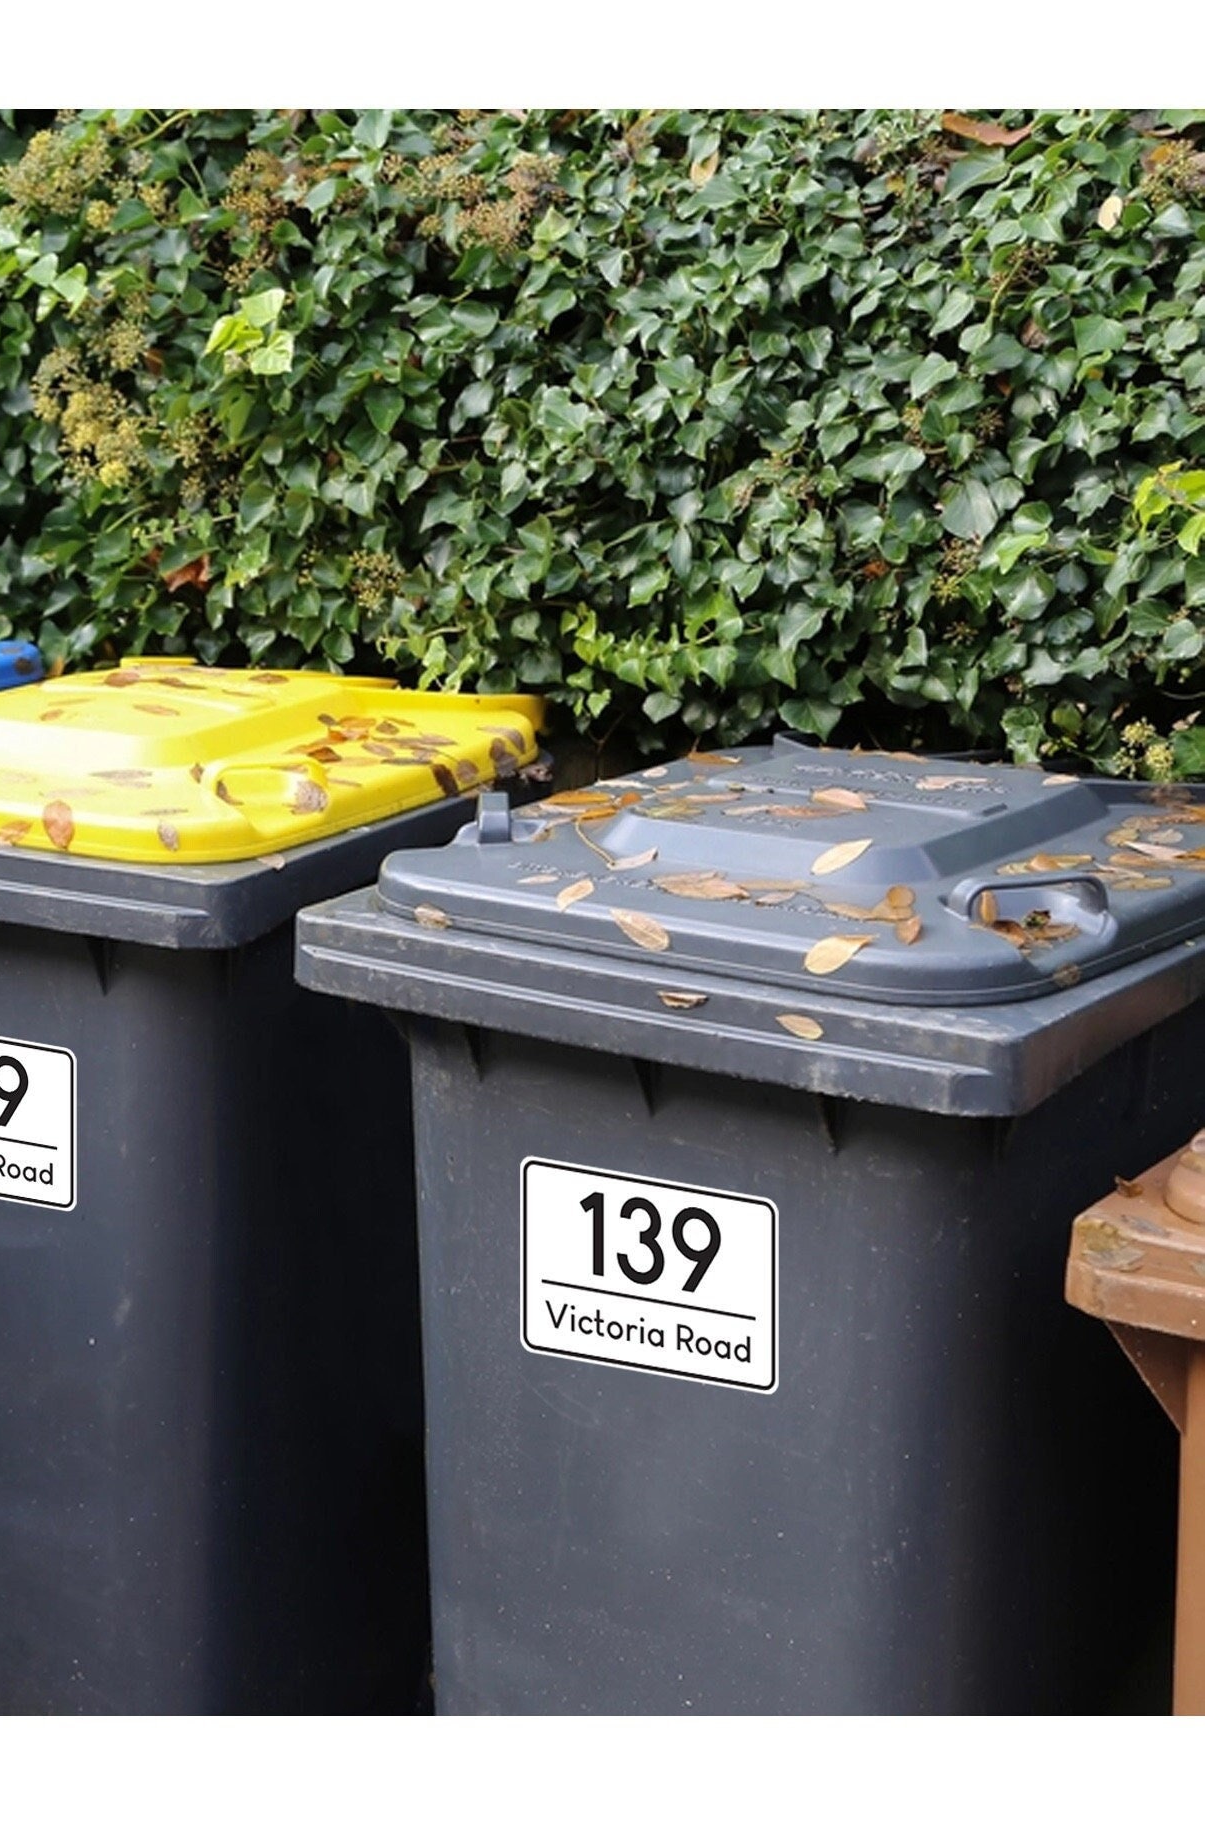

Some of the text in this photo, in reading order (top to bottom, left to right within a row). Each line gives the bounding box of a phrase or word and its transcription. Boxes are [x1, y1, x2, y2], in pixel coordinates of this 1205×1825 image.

[580, 1192, 722, 1293] 139
[546, 1301, 751, 1363] Victoria Road
